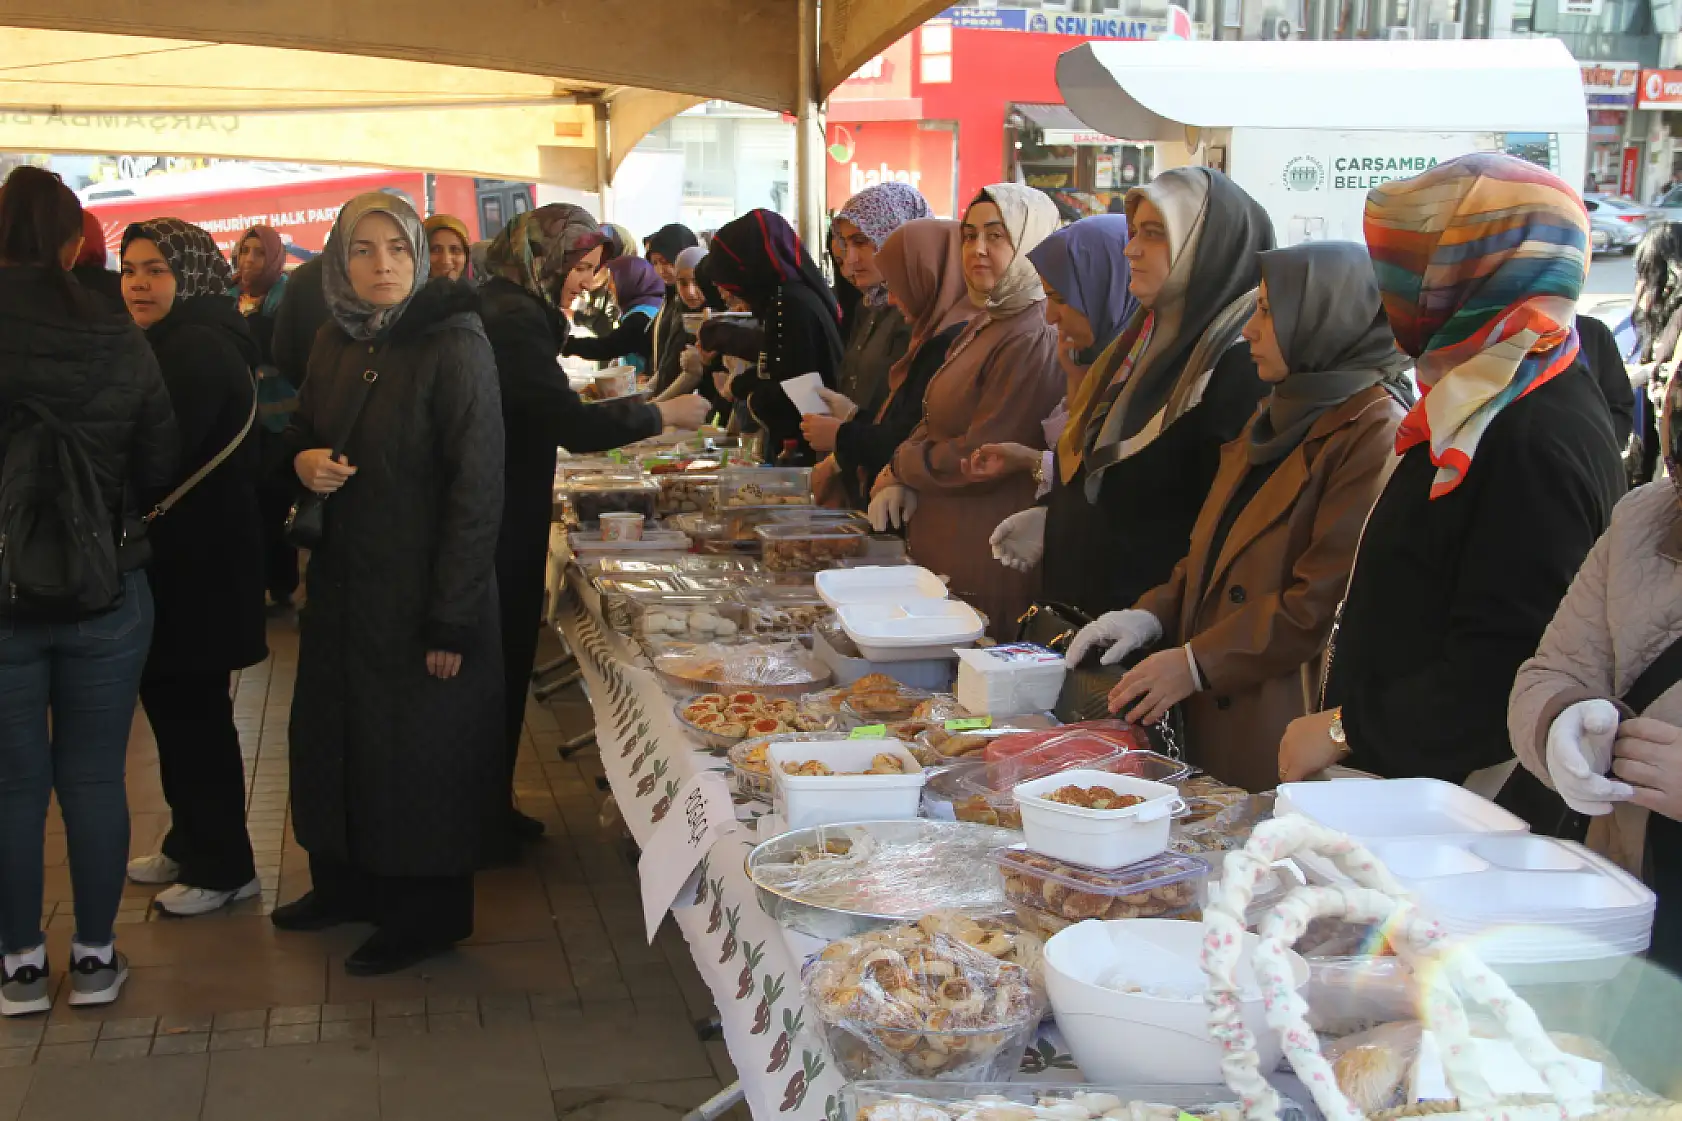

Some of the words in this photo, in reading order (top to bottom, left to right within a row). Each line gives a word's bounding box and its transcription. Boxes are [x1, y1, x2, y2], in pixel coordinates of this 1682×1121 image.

[1335, 157, 1438, 172] ÇARŞAMBA
[270, 208, 305, 228] HALK
[307, 203, 344, 223] PART
